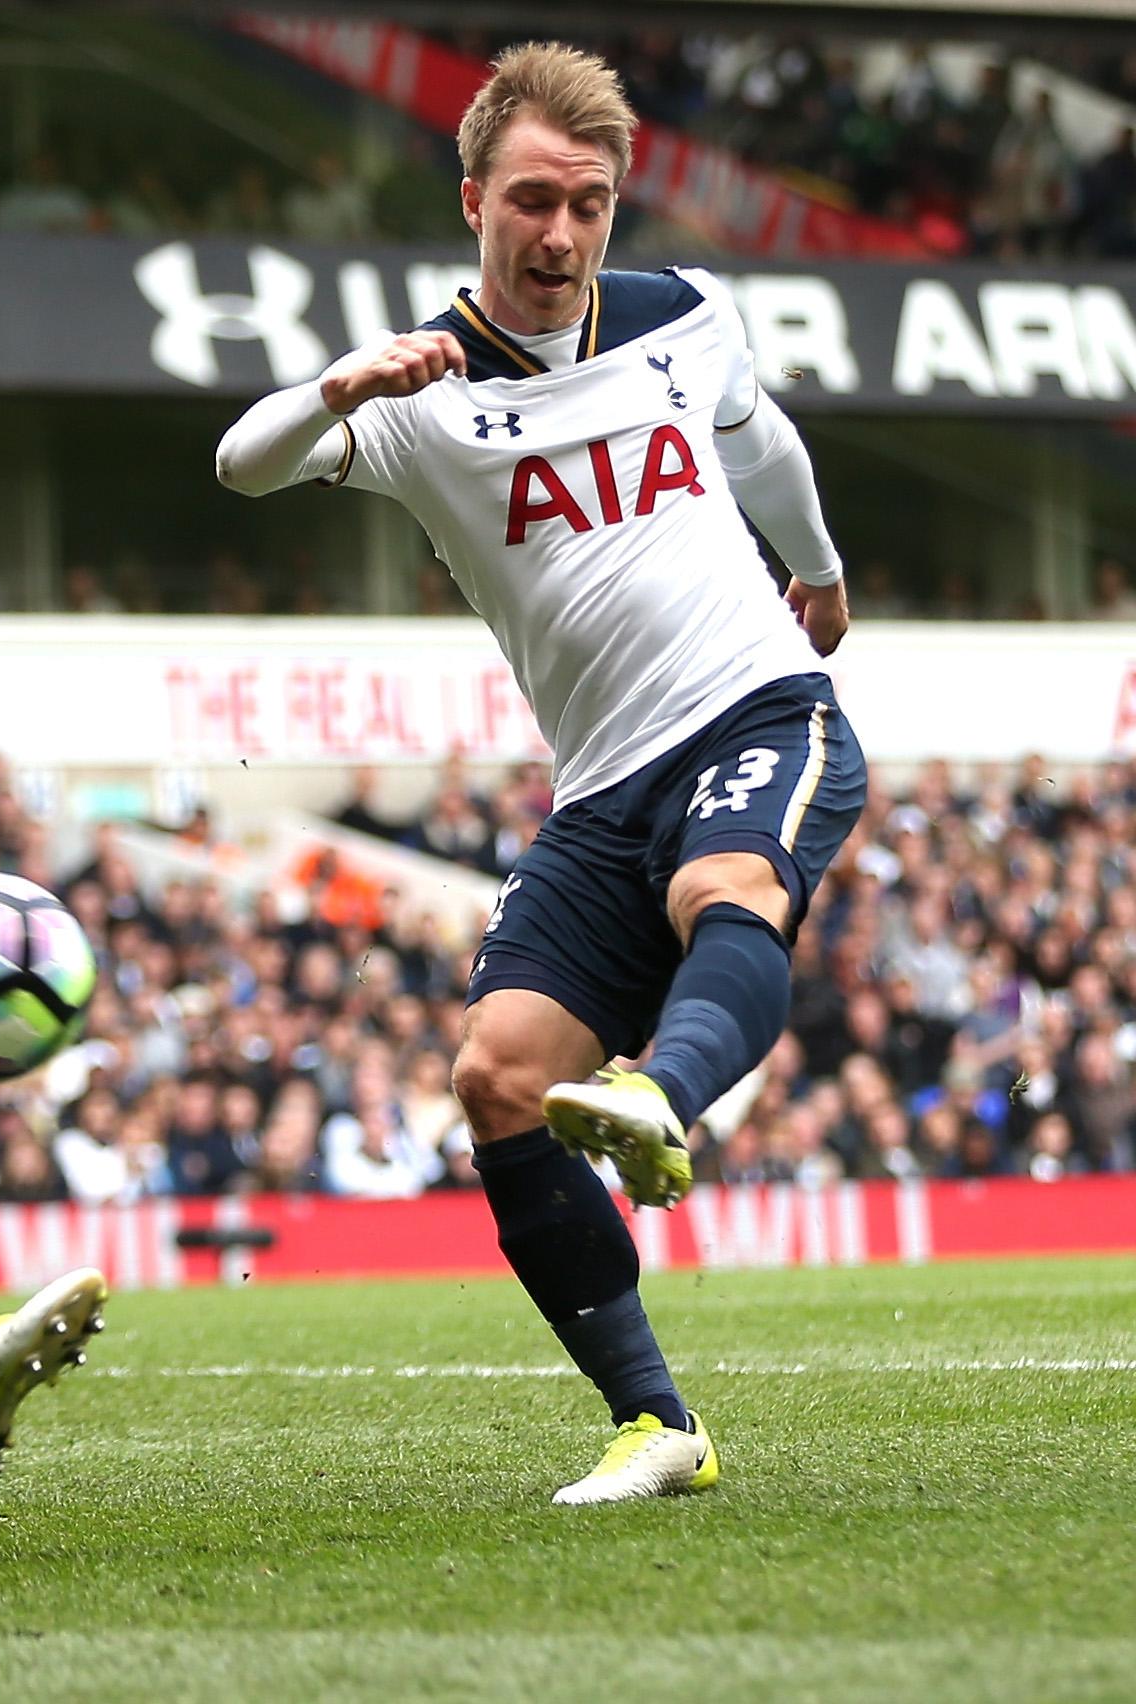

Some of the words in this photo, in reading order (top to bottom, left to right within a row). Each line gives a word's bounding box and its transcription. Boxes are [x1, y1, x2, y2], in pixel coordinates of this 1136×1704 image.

[505, 424, 706, 546] AIA
[165, 660, 268, 757] THE
[280, 660, 426, 757] REAL
